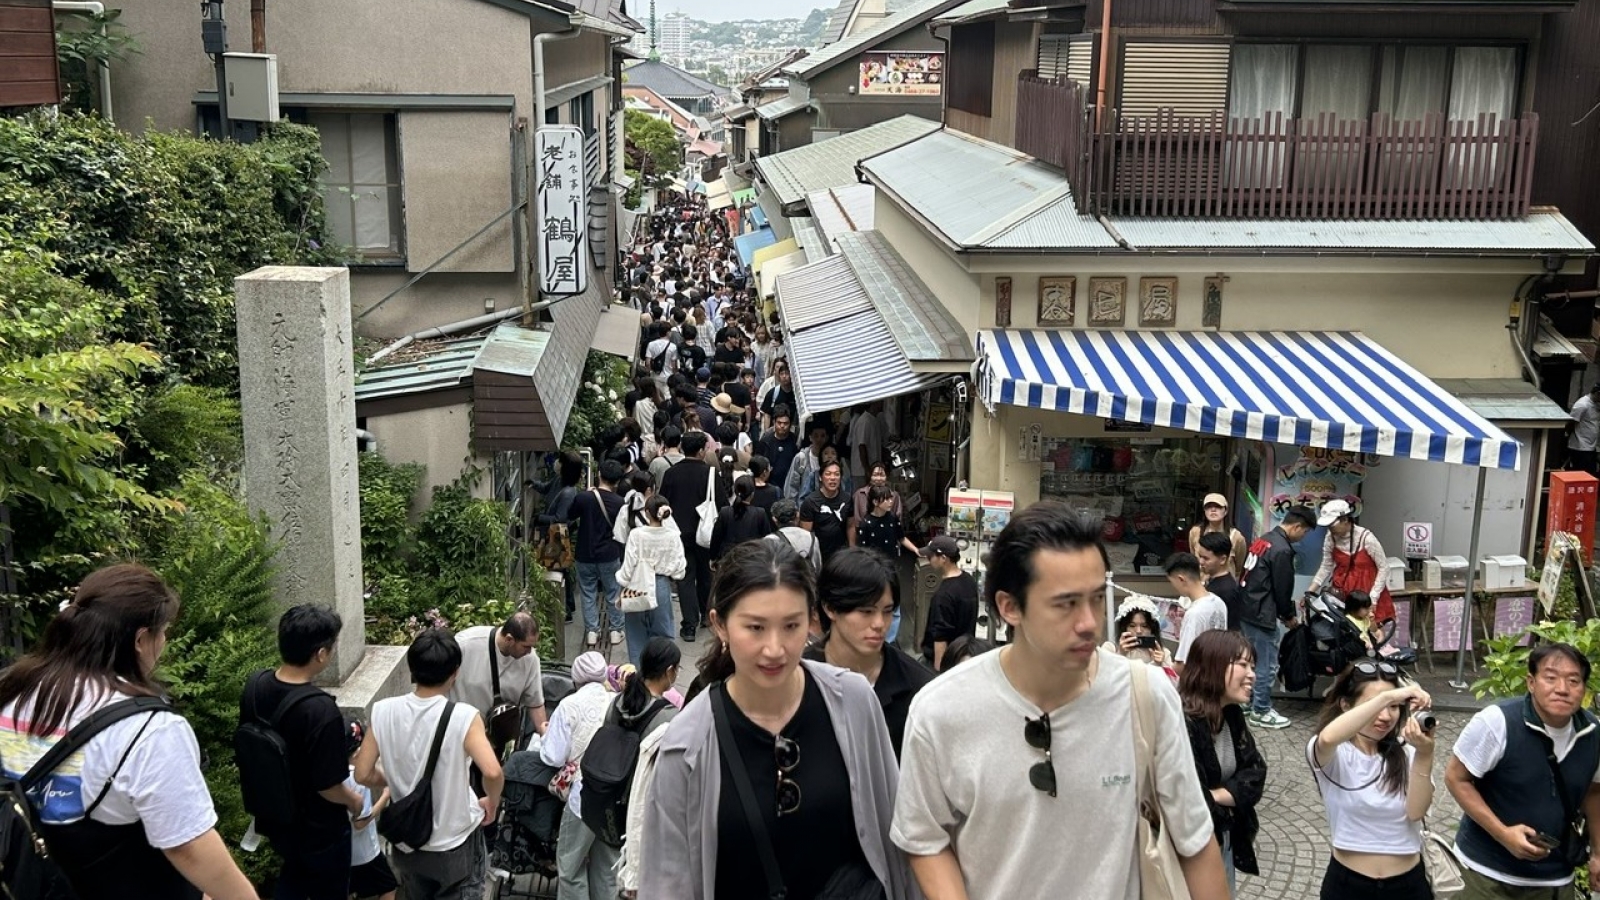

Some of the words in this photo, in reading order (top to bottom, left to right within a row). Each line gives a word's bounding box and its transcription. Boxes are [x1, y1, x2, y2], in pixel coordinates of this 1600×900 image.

[1283, 460, 1362, 481] レインボー
